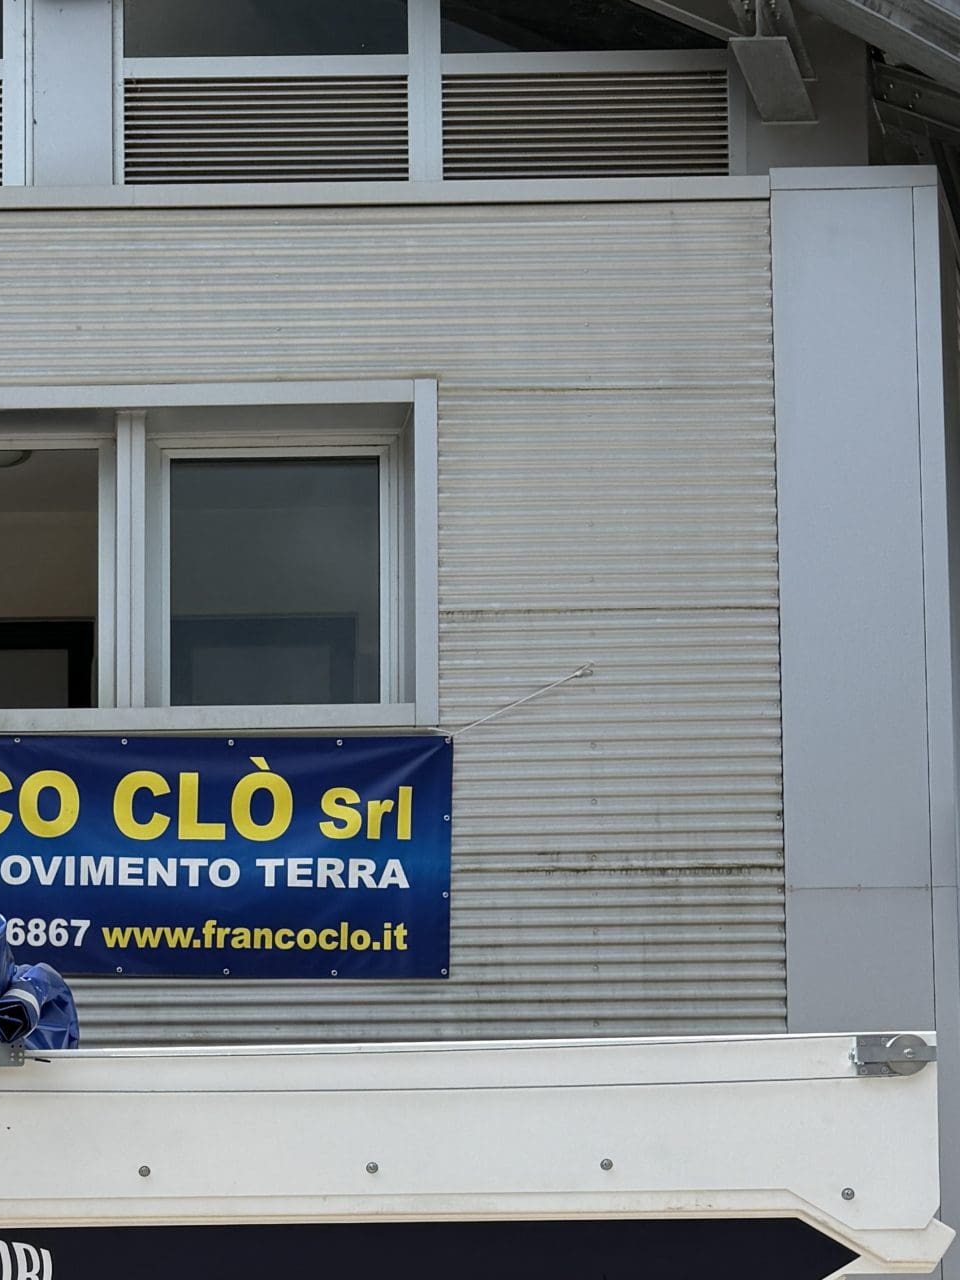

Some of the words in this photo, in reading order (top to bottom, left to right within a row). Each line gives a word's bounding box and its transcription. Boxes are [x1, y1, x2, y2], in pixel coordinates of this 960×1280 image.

[113, 756, 293, 841] CLÒ
[319, 786, 413, 840] Srl
[255, 858, 410, 888] TERRA
[102, 920, 408, 950] www.francoclo.it
